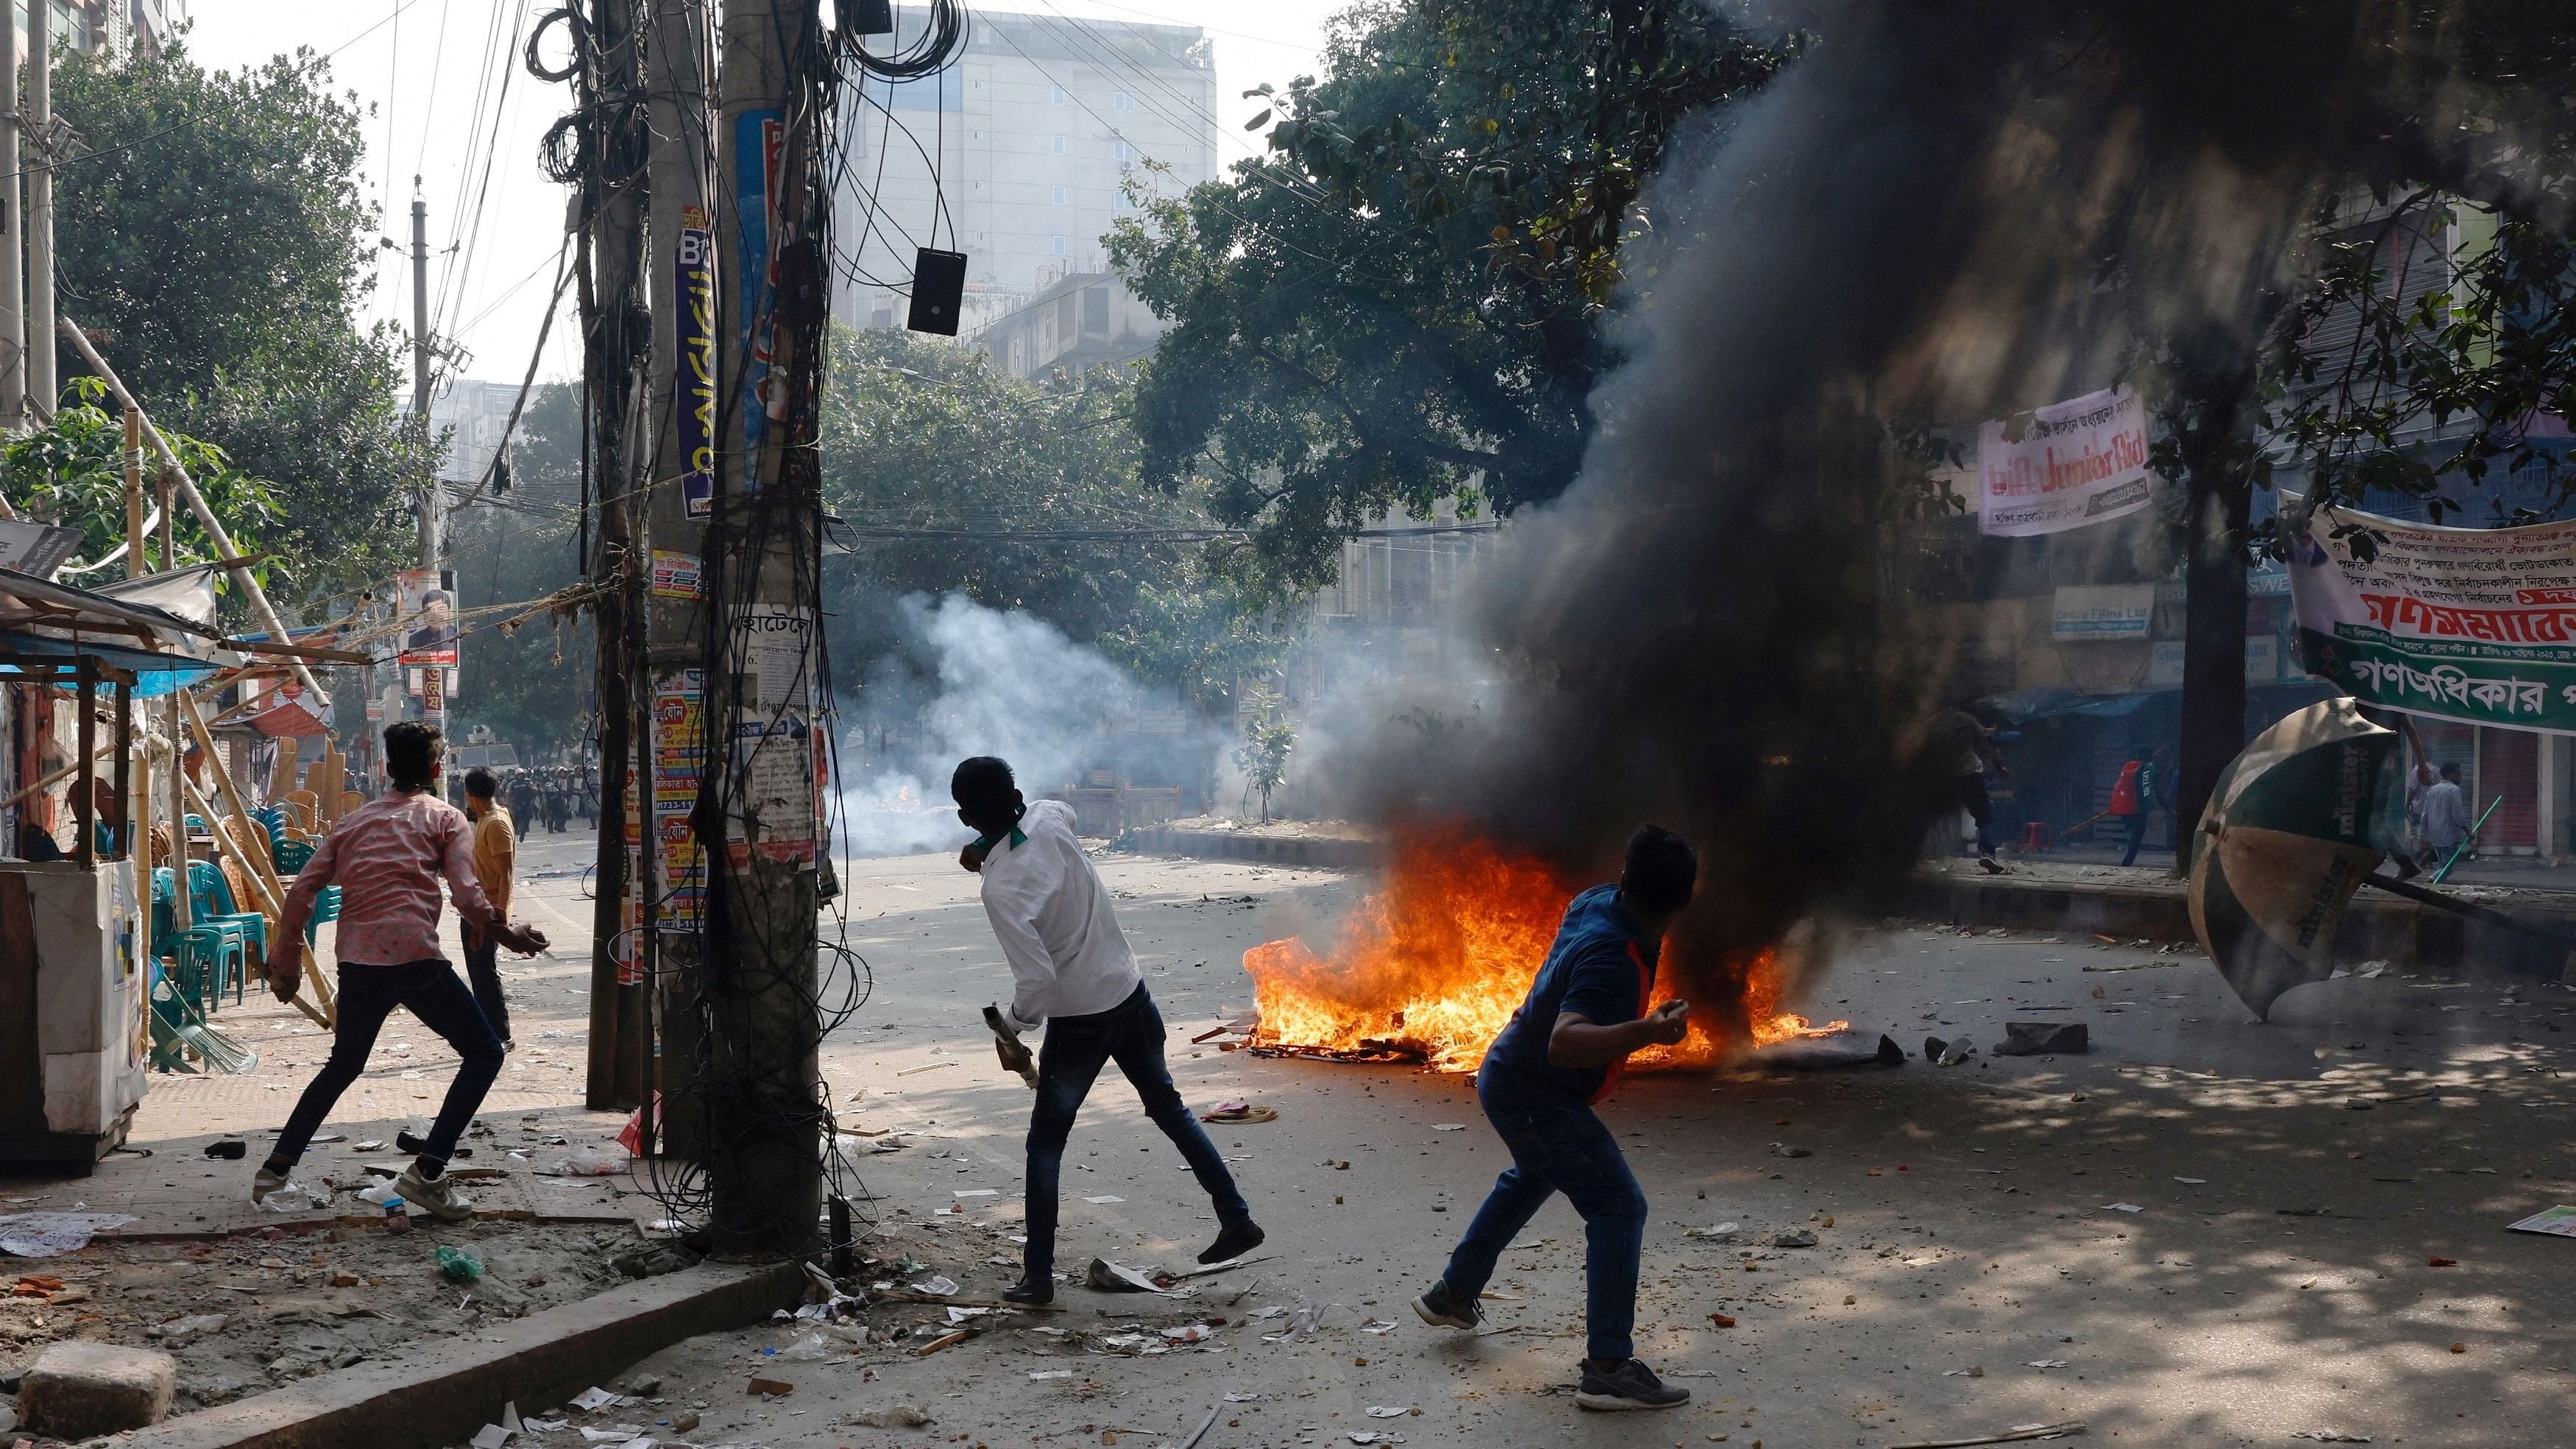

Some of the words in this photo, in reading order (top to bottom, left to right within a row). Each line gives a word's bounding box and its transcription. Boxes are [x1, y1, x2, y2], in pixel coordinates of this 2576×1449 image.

[2042, 447, 2112, 492] Junior
[2112, 430, 2143, 472] Aid
[2395, 542, 2432, 552] বিরুদ্ধে
[2549, 543, 2572, 552] হোন
[668, 559, 695, 571] ডিজিটাল
[2458, 559, 2506, 571] গণবিরোধী
[2510, 558, 2573, 570] ভোটডাকাত
[2454, 576, 2522, 589] নির্বাচনকালীন
[2525, 575, 2569, 588] নিরপেক্ষ
[2466, 592, 2513, 603] নির্বাচনের
[2520, 592, 2533, 603] ১
[2092, 608, 2122, 619] Films
[2351, 656, 2548, 715] গণঅধিকার
[665, 701, 683, 721] যৌন
[669, 820, 688, 840] যৌন
